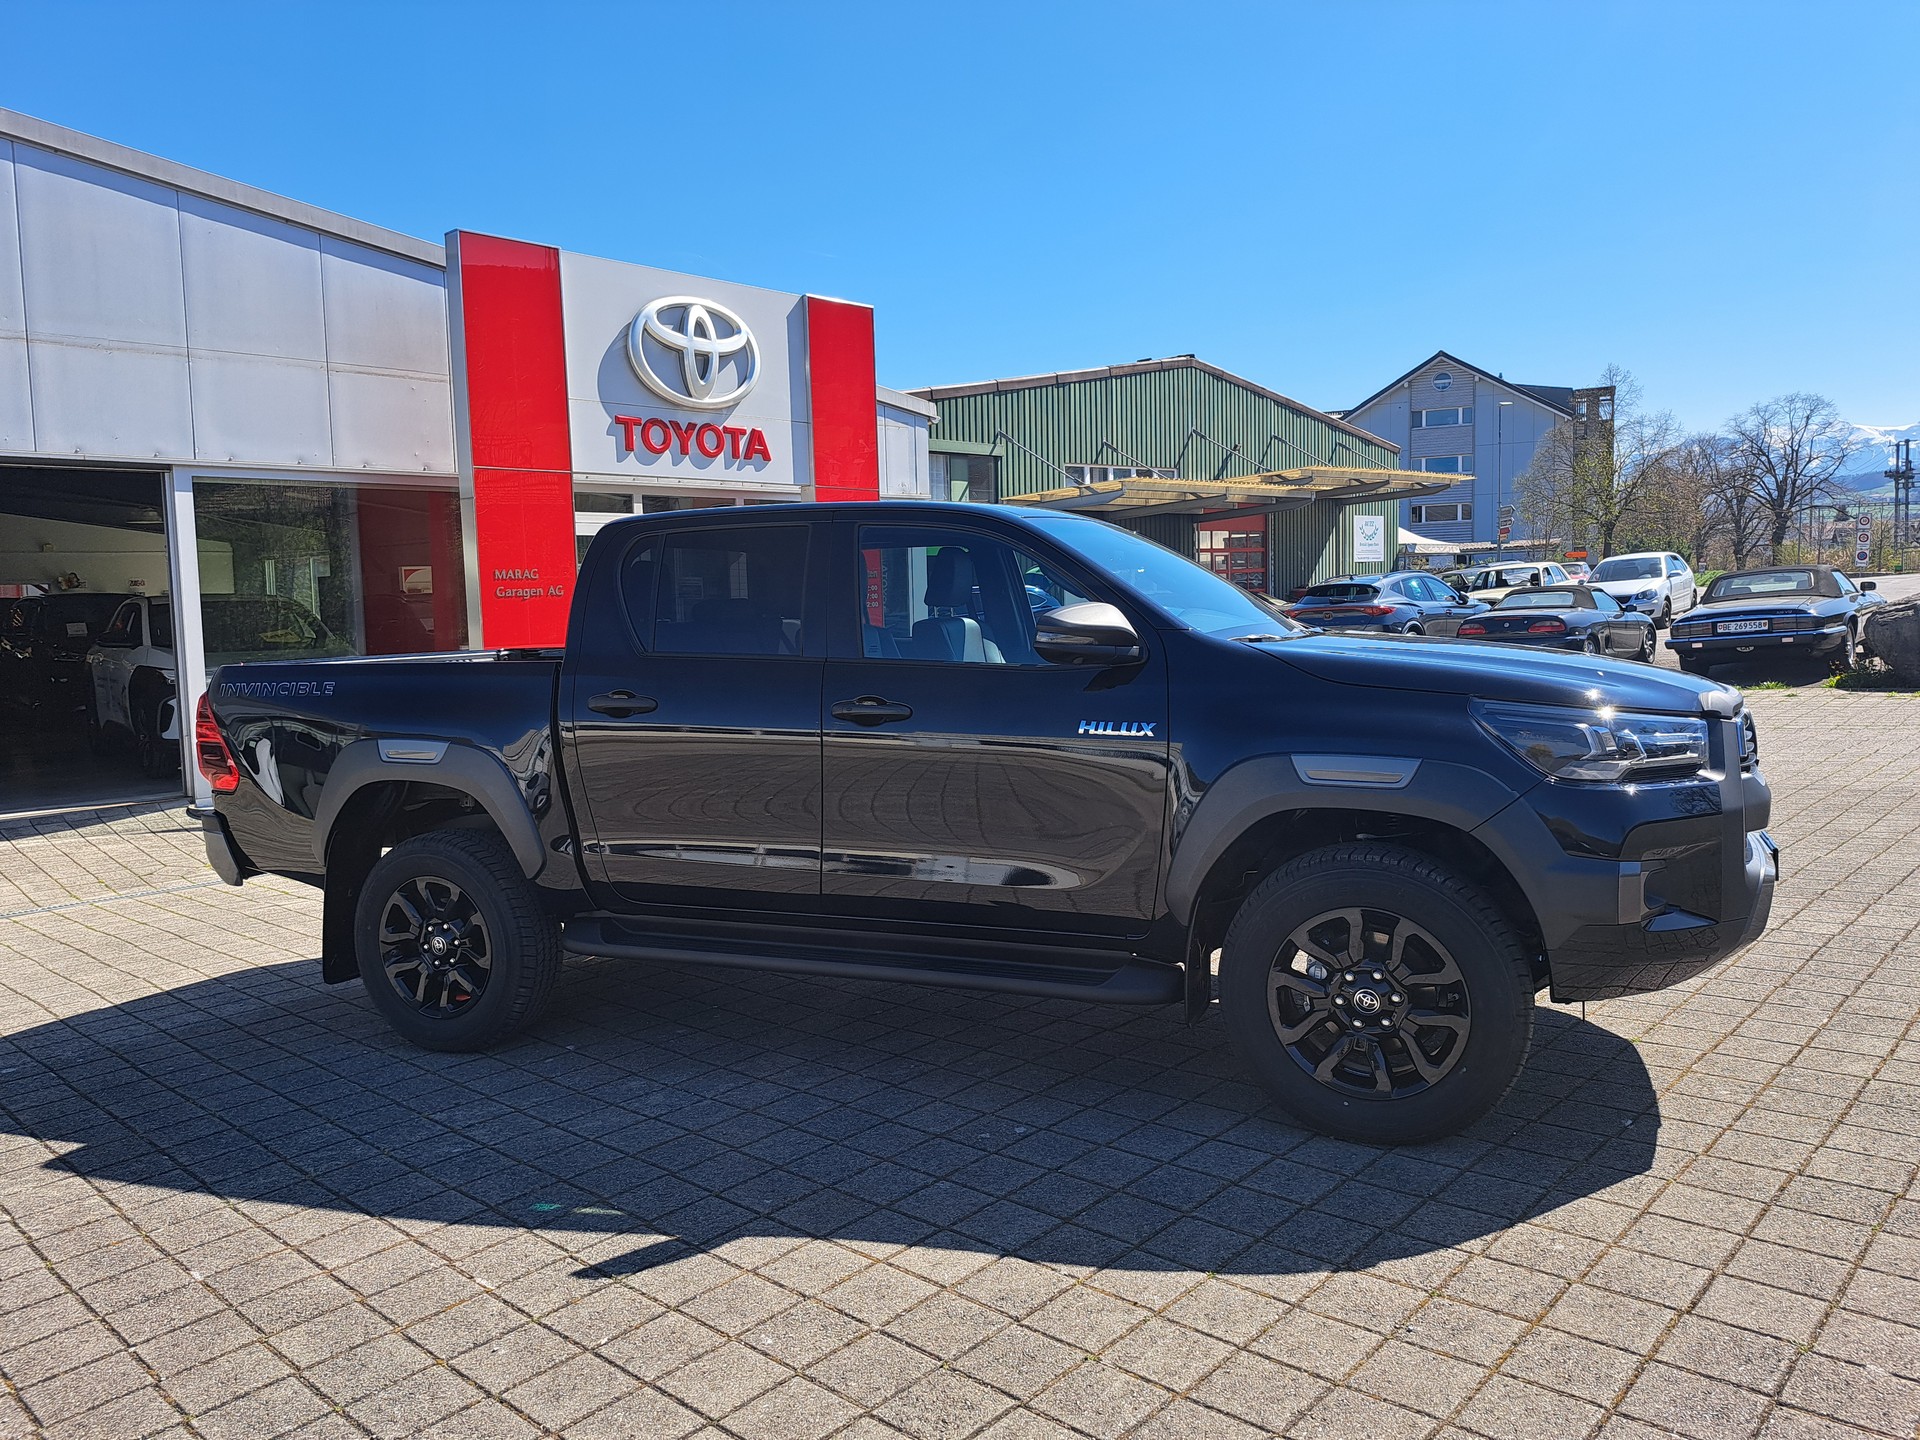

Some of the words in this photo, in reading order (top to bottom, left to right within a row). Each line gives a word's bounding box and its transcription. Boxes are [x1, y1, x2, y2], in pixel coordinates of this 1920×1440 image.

[615, 414, 772, 461] TOYOTA
[495, 568, 539, 580] MARAG
[496, 586, 543, 599] Garagen
[548, 585, 564, 596] AG
[220, 681, 336, 697] INVINCIBLE
[1078, 719, 1157, 737] HILUX
